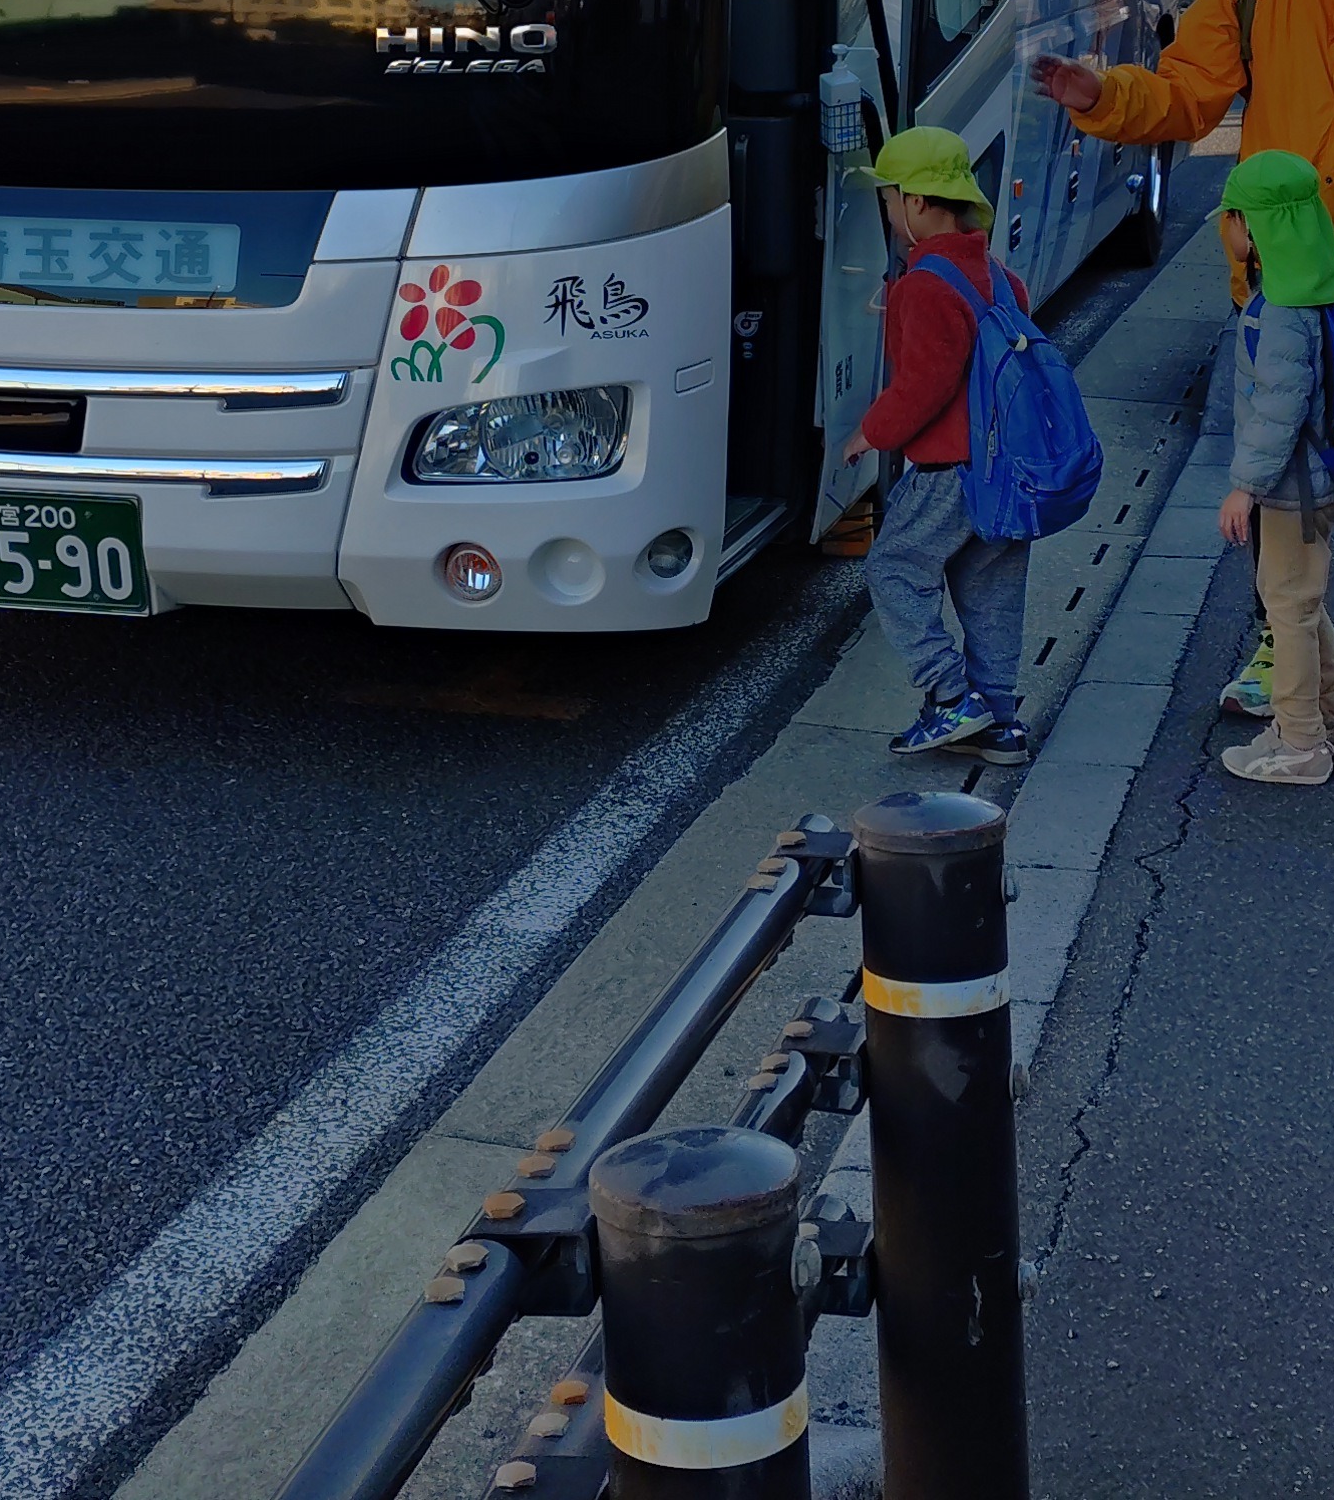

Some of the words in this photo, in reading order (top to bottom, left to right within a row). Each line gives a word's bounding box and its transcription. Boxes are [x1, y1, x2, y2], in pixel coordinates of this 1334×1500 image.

[376, 23, 558, 54] HINO
[543, 272, 650, 337] 飛鳥
[590, 329, 650, 340] ASUKA
